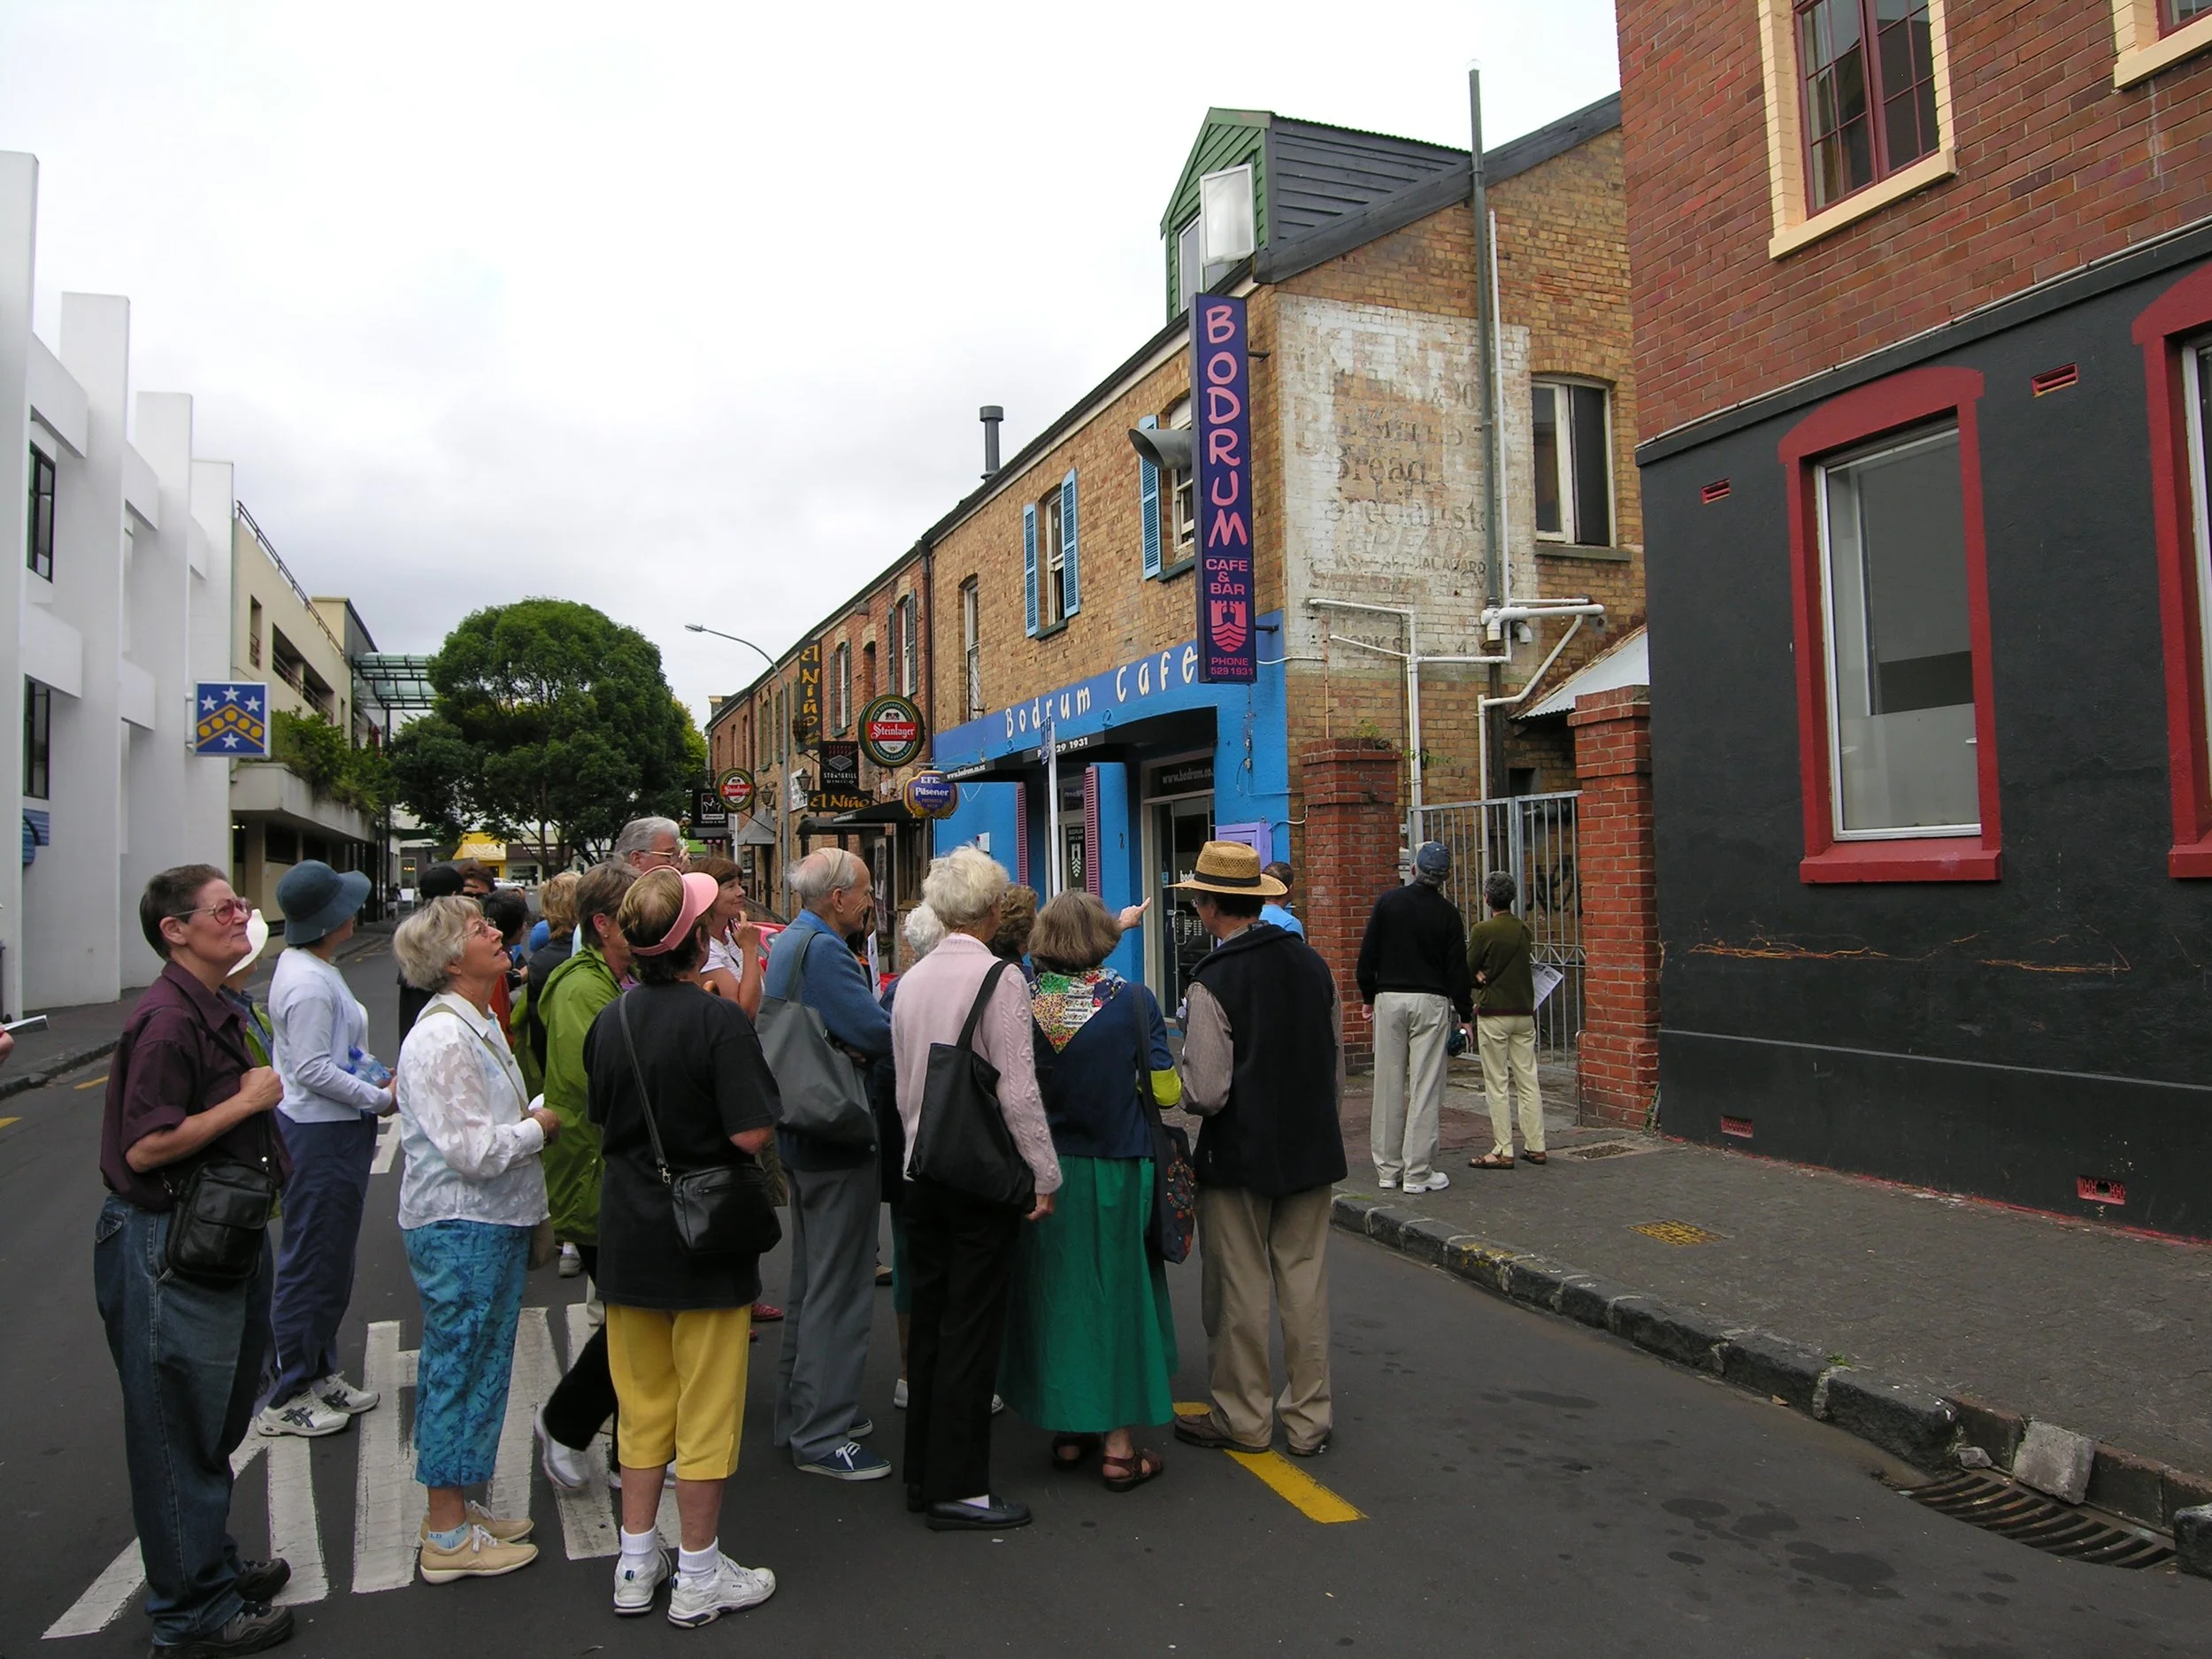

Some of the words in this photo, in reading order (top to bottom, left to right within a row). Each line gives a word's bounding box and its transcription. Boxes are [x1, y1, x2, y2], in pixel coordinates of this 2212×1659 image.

[1205, 304, 1248, 548] BODRUM
[1206, 558, 1248, 572] CAFE
[1217, 572, 1230, 582] &
[1210, 583, 1245, 595] BAR
[1211, 657, 1248, 666] PHONE
[1005, 686, 1091, 738] Bodrum
[1116, 645, 1198, 703] Cafe
[870, 722, 915, 739] Steinlager
[1069, 737, 1088, 749] 1931
[915, 787, 949, 796] Pilsener
[810, 794, 827, 809] El
[830, 795, 869, 809] Niño
